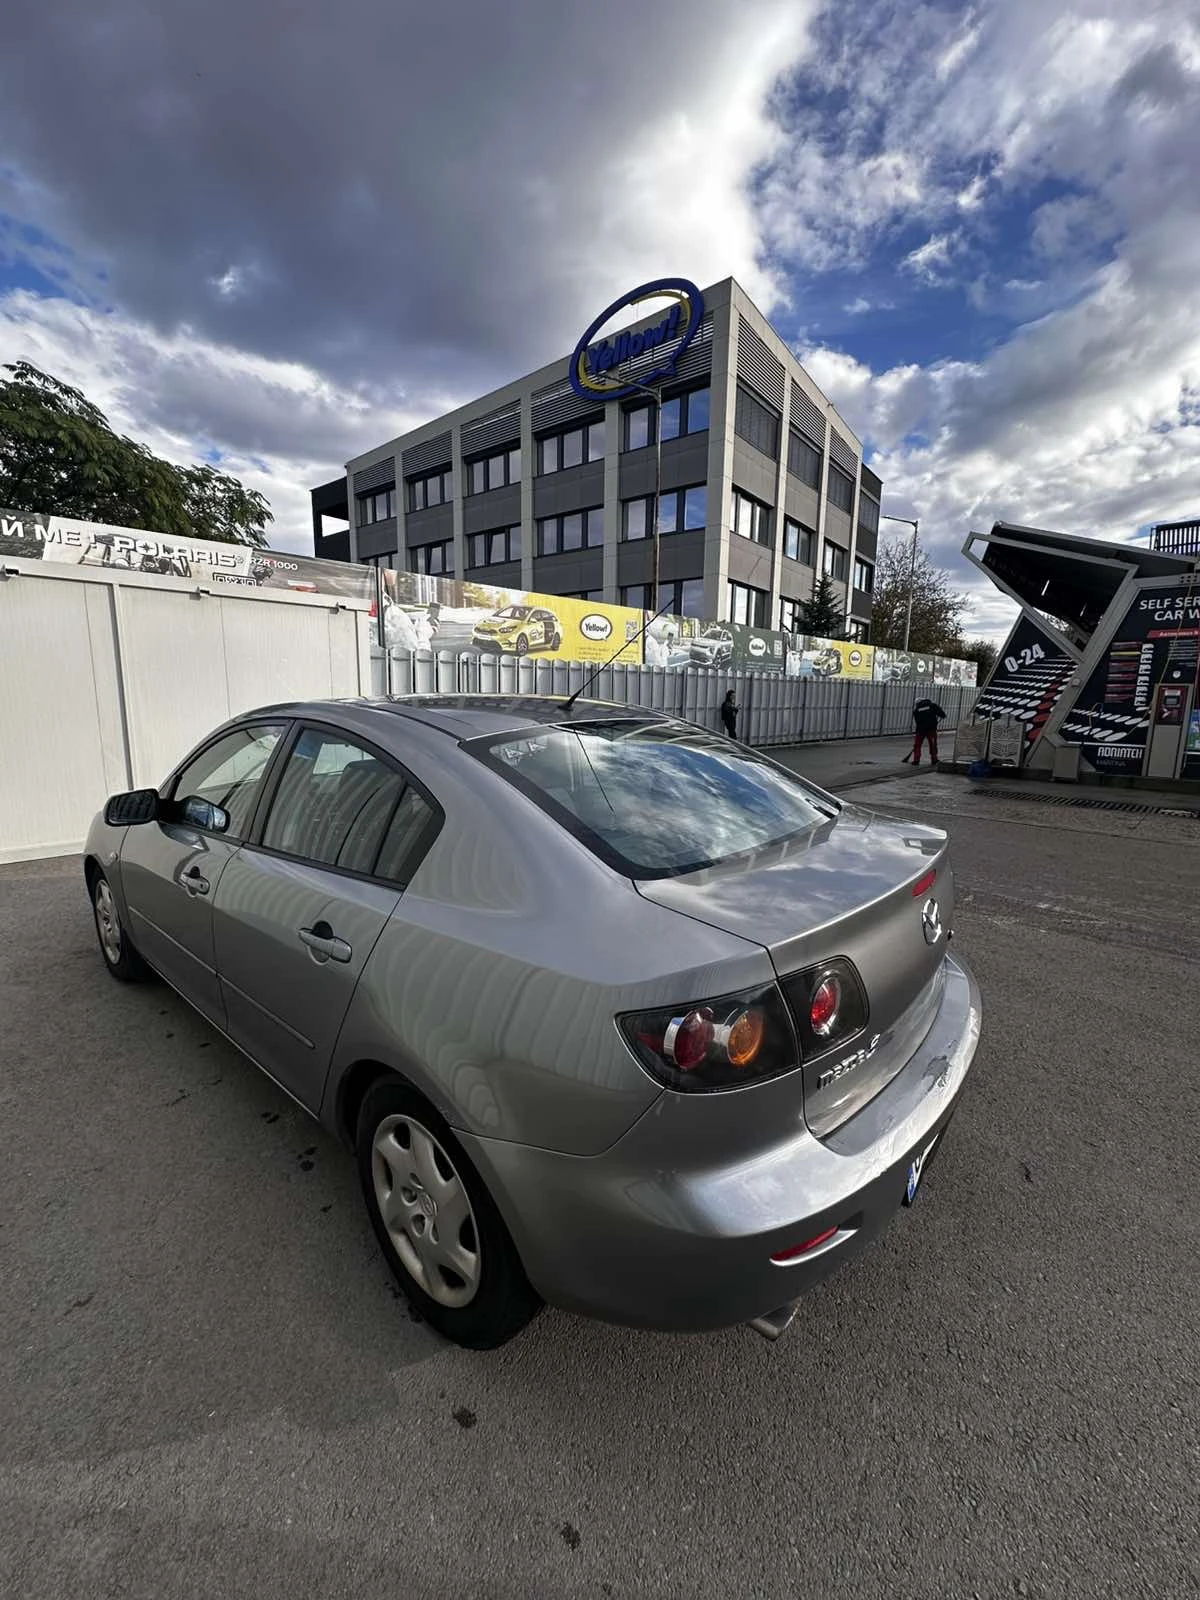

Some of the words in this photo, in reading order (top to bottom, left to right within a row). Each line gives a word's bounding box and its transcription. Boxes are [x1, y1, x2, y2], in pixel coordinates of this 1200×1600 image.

[588, 304, 681, 374] Yellow!
[113, 535, 238, 568] POLARIS
[274, 560, 298, 571] 1000
[1139, 598, 1172, 609] SELF
[1154, 610, 1184, 620] CAR
[585, 622, 608, 632] Yellow!
[1005, 643, 1045, 672] 0-24
